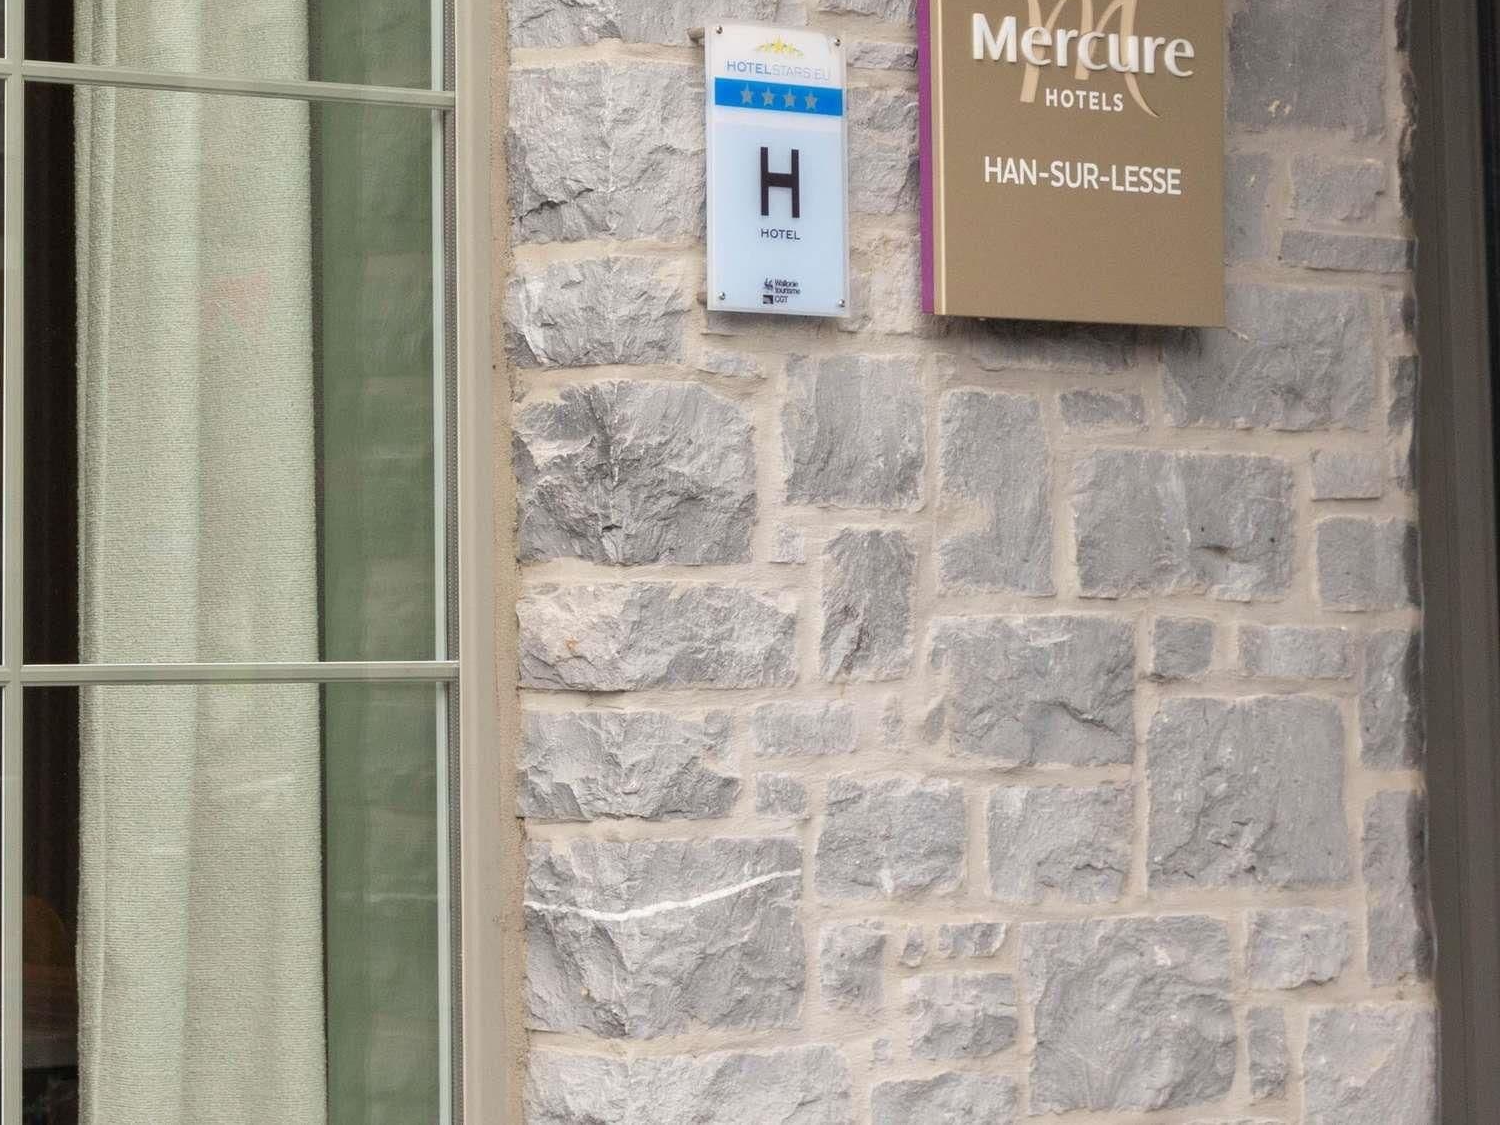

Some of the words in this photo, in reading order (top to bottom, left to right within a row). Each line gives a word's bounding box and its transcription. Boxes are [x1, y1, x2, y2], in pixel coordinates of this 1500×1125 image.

[972, 12, 1195, 78] Mercure
[1045, 87, 1124, 112] HOTELS
[760, 146, 800, 218] H
[984, 155, 1182, 195] HAN-SUR-LESSE
[761, 228, 800, 241] HOTEL
